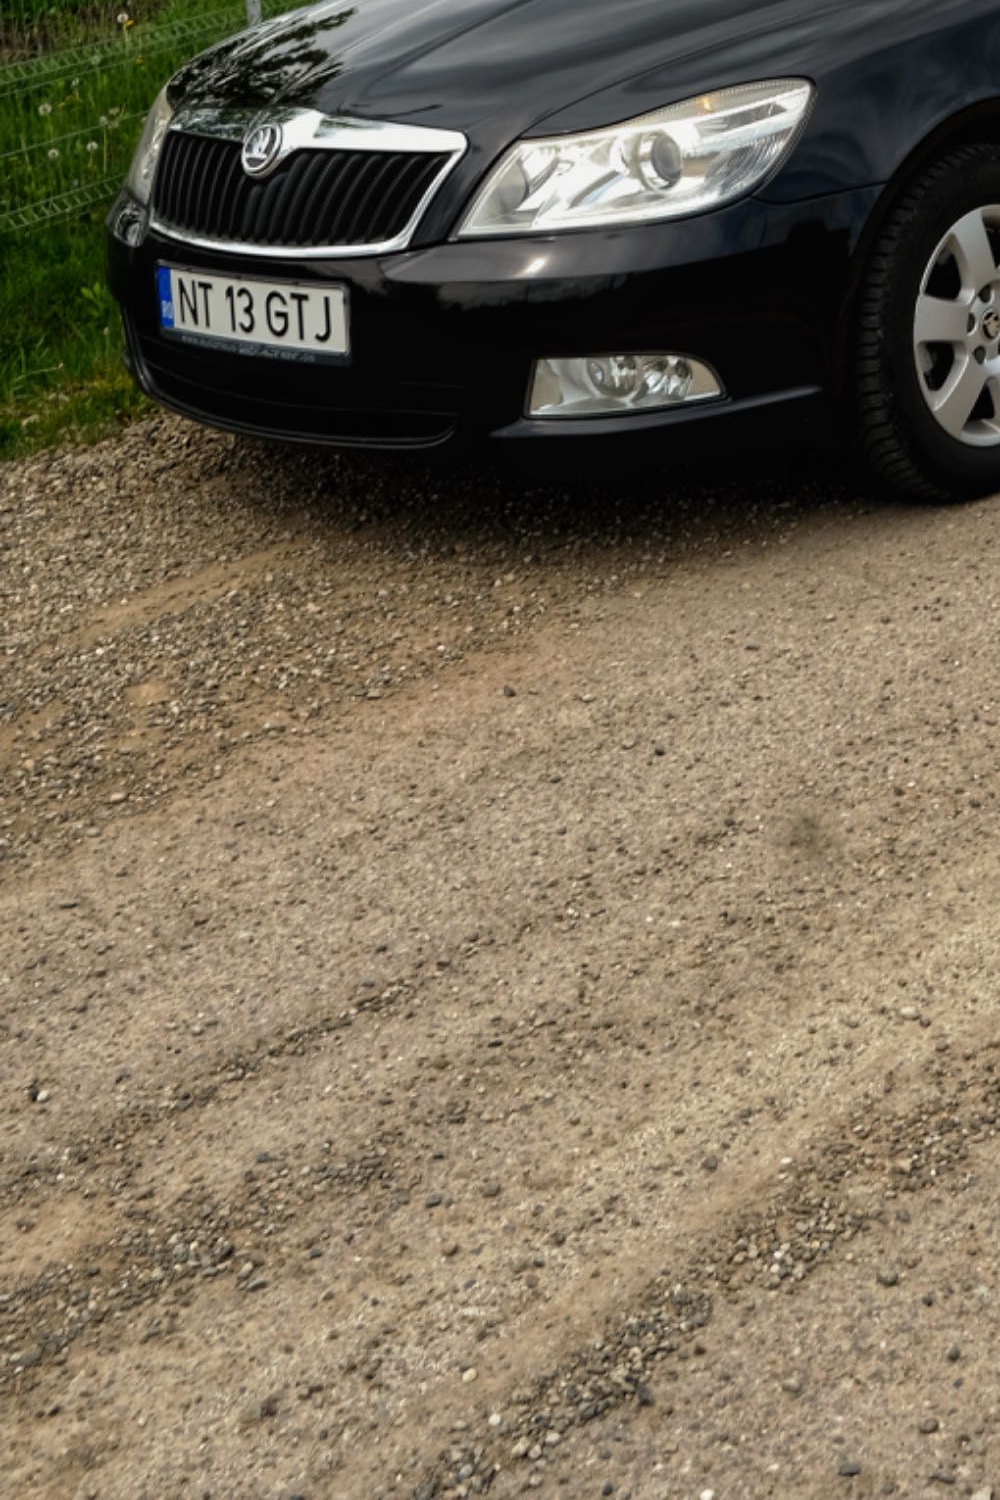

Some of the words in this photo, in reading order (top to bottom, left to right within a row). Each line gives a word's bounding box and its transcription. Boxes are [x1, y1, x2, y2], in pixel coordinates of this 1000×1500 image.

[178, 278, 213, 329] NT
[225, 285, 255, 334] 13
[266, 291, 332, 343] GTJ
